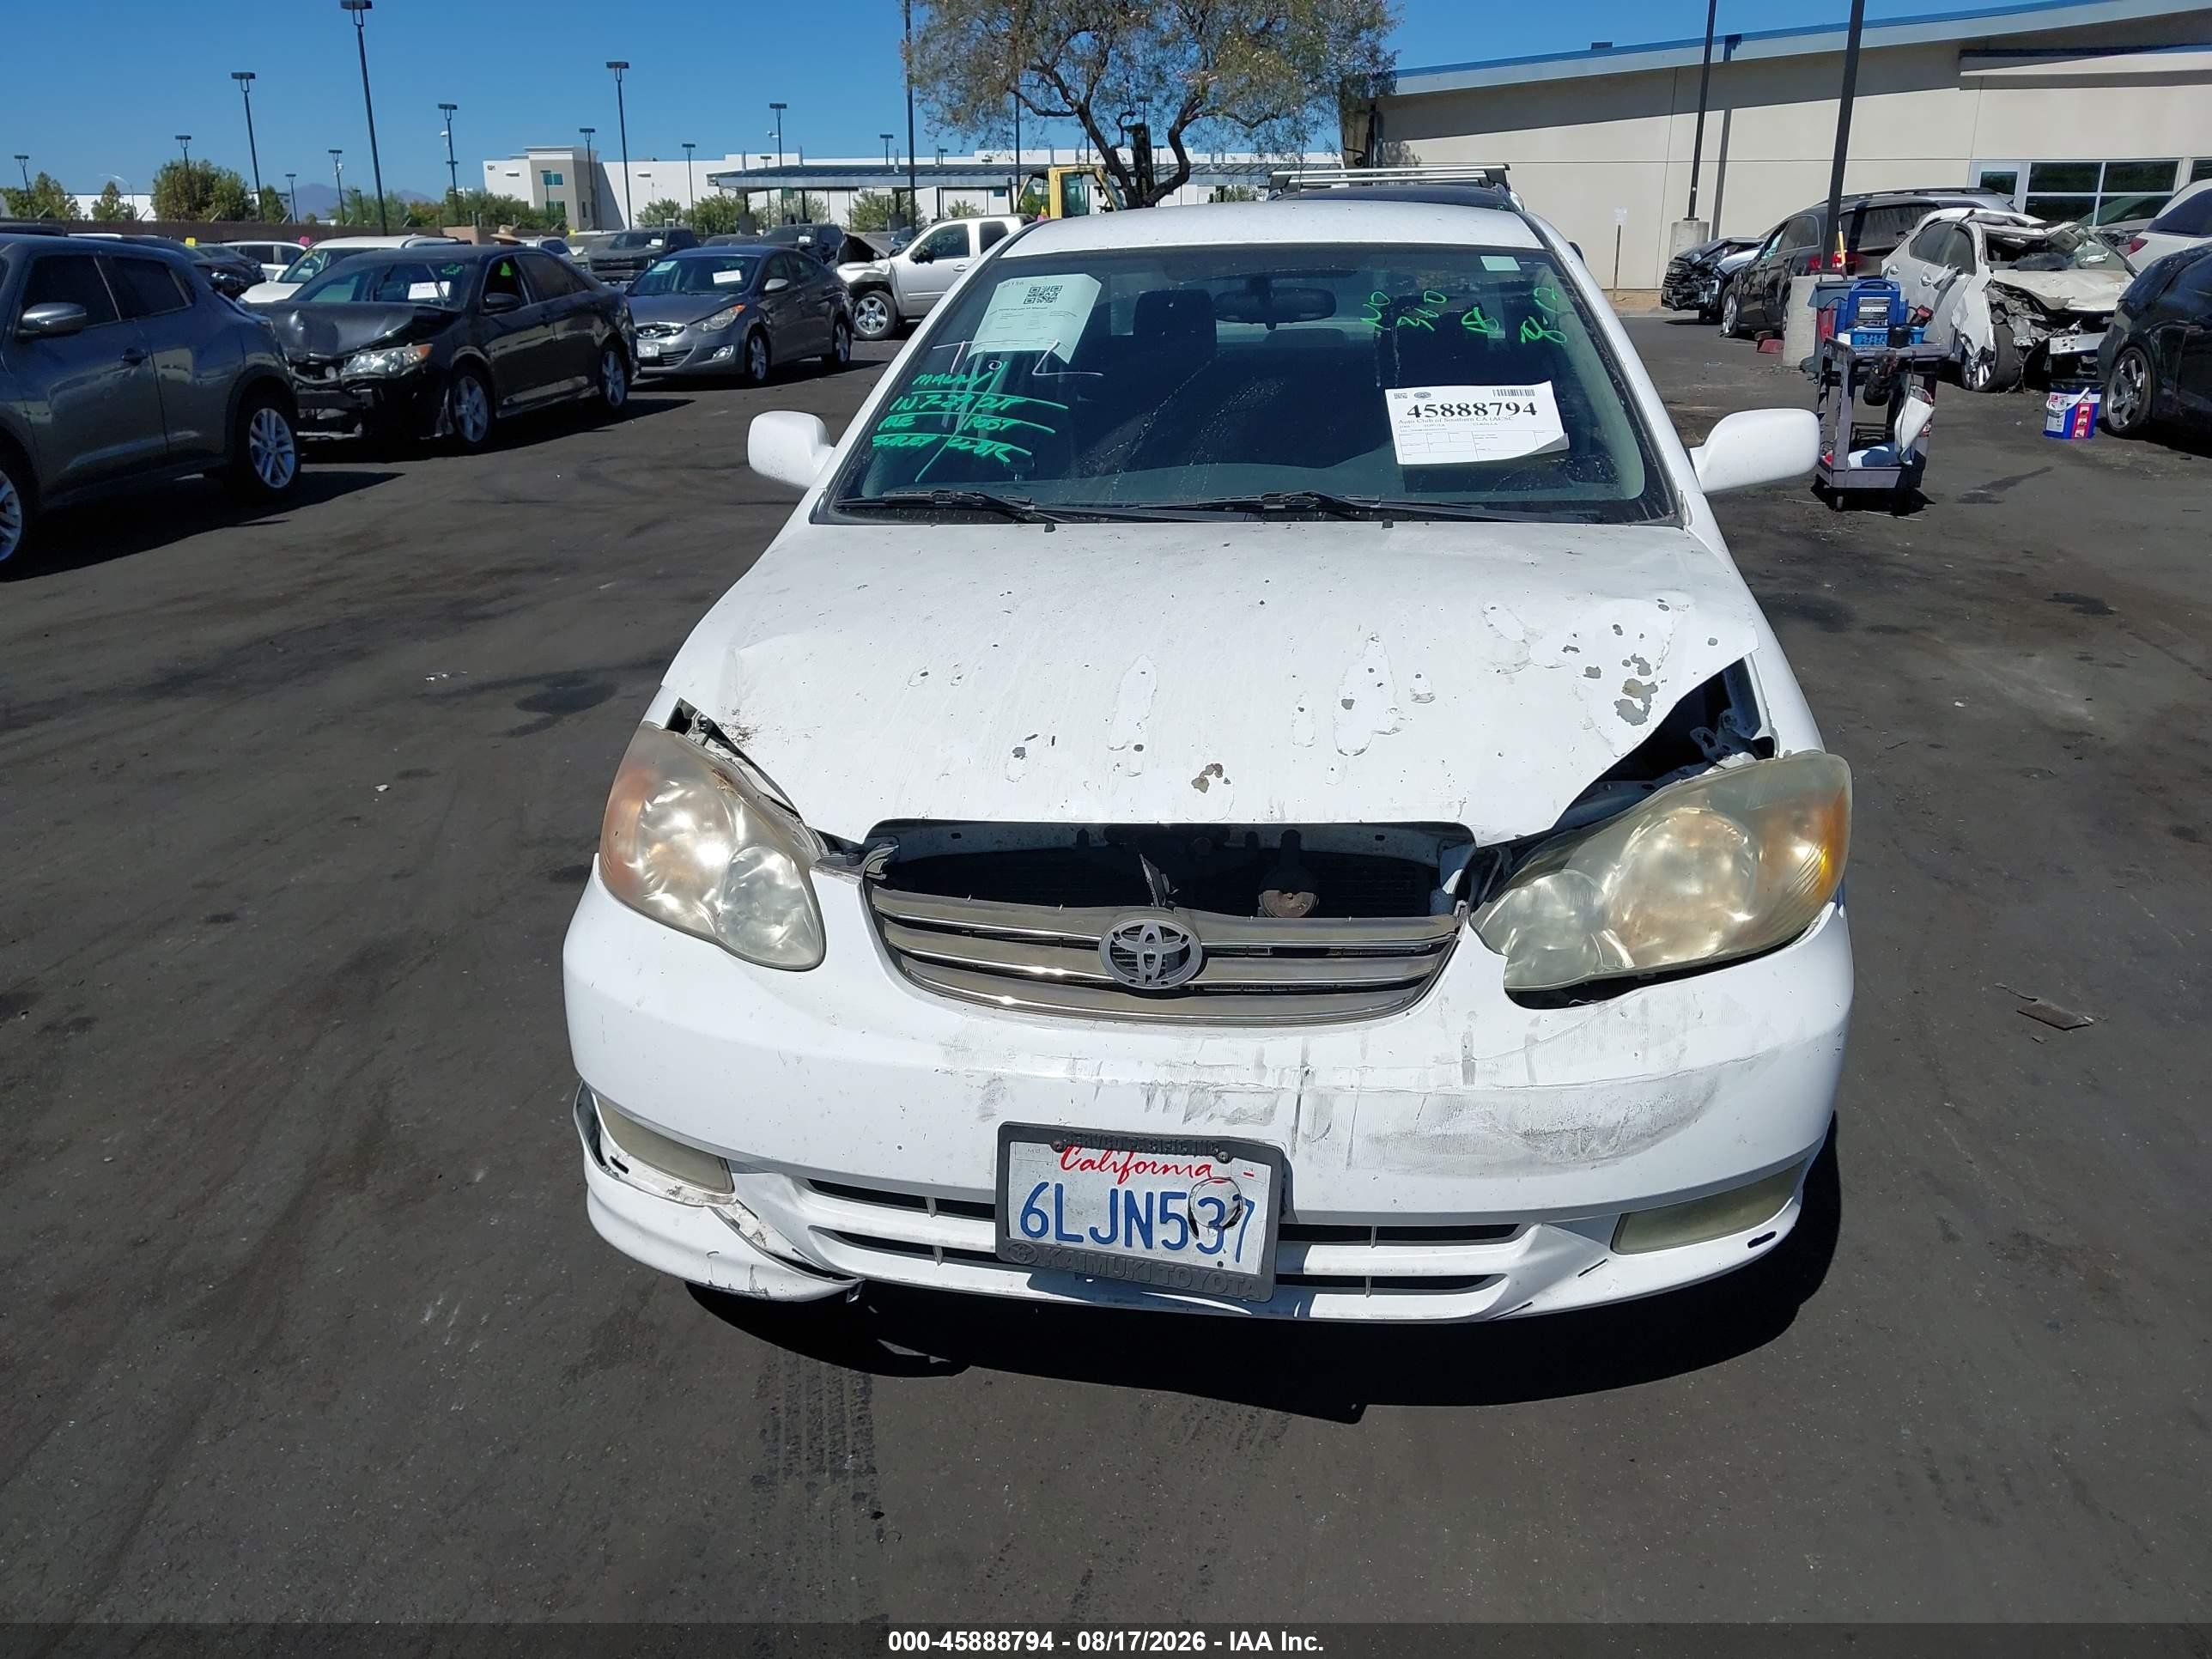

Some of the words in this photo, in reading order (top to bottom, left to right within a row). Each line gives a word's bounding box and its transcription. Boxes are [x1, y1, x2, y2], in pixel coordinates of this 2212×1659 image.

[1407, 401, 1538, 418] 45888794
[1059, 1143, 1215, 1186] California
[1018, 1180, 1256, 1264] 6LJN537
[1044, 1247, 1152, 1282] KAIMUKI
[1158, 1264, 1261, 1299] TOYOTA
